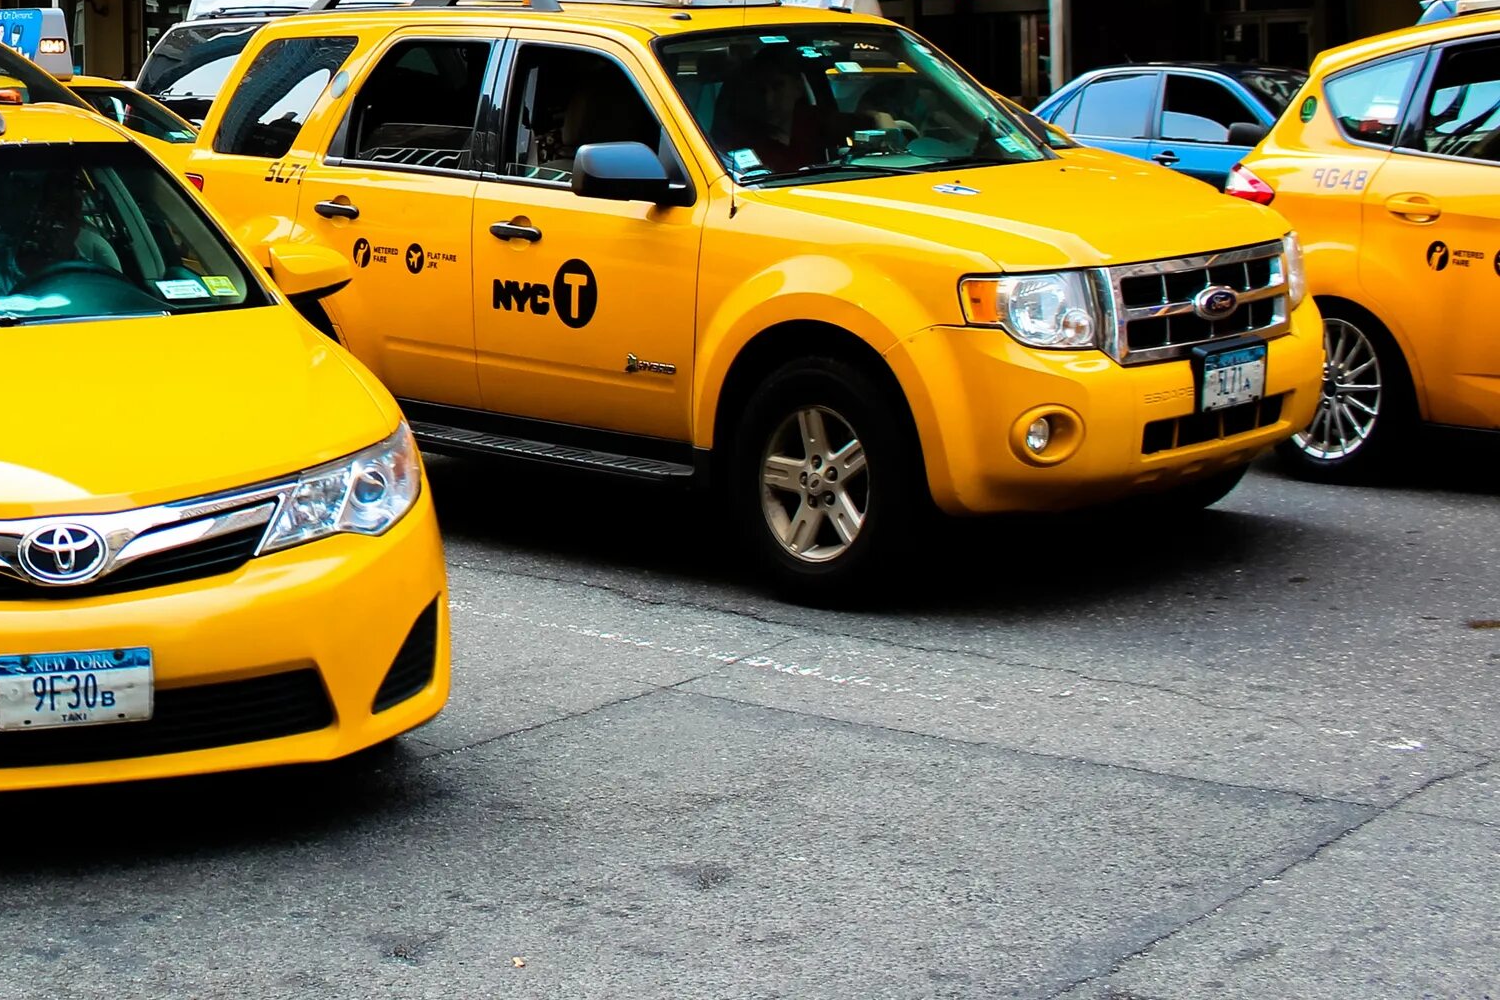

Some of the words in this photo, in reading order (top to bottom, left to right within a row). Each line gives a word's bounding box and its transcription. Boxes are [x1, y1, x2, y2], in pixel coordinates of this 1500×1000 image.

[1312, 168, 1369, 191] 9G48
[373, 246, 399, 256] METERED
[1452, 249, 1485, 260] METERED
[373, 255, 388, 264] FARE
[427, 252, 441, 261] FLAT
[442, 253, 457, 263] FARE
[426, 261, 438, 269] JFK
[1452, 259, 1470, 268] FARE
[492, 278, 550, 315] NYC
[563, 273, 589, 319] T
[637, 361, 677, 376] HYBRID
[33, 659, 71, 673] NEW
[72, 655, 114, 670] YORK
[62, 713, 88, 723] TAXI
